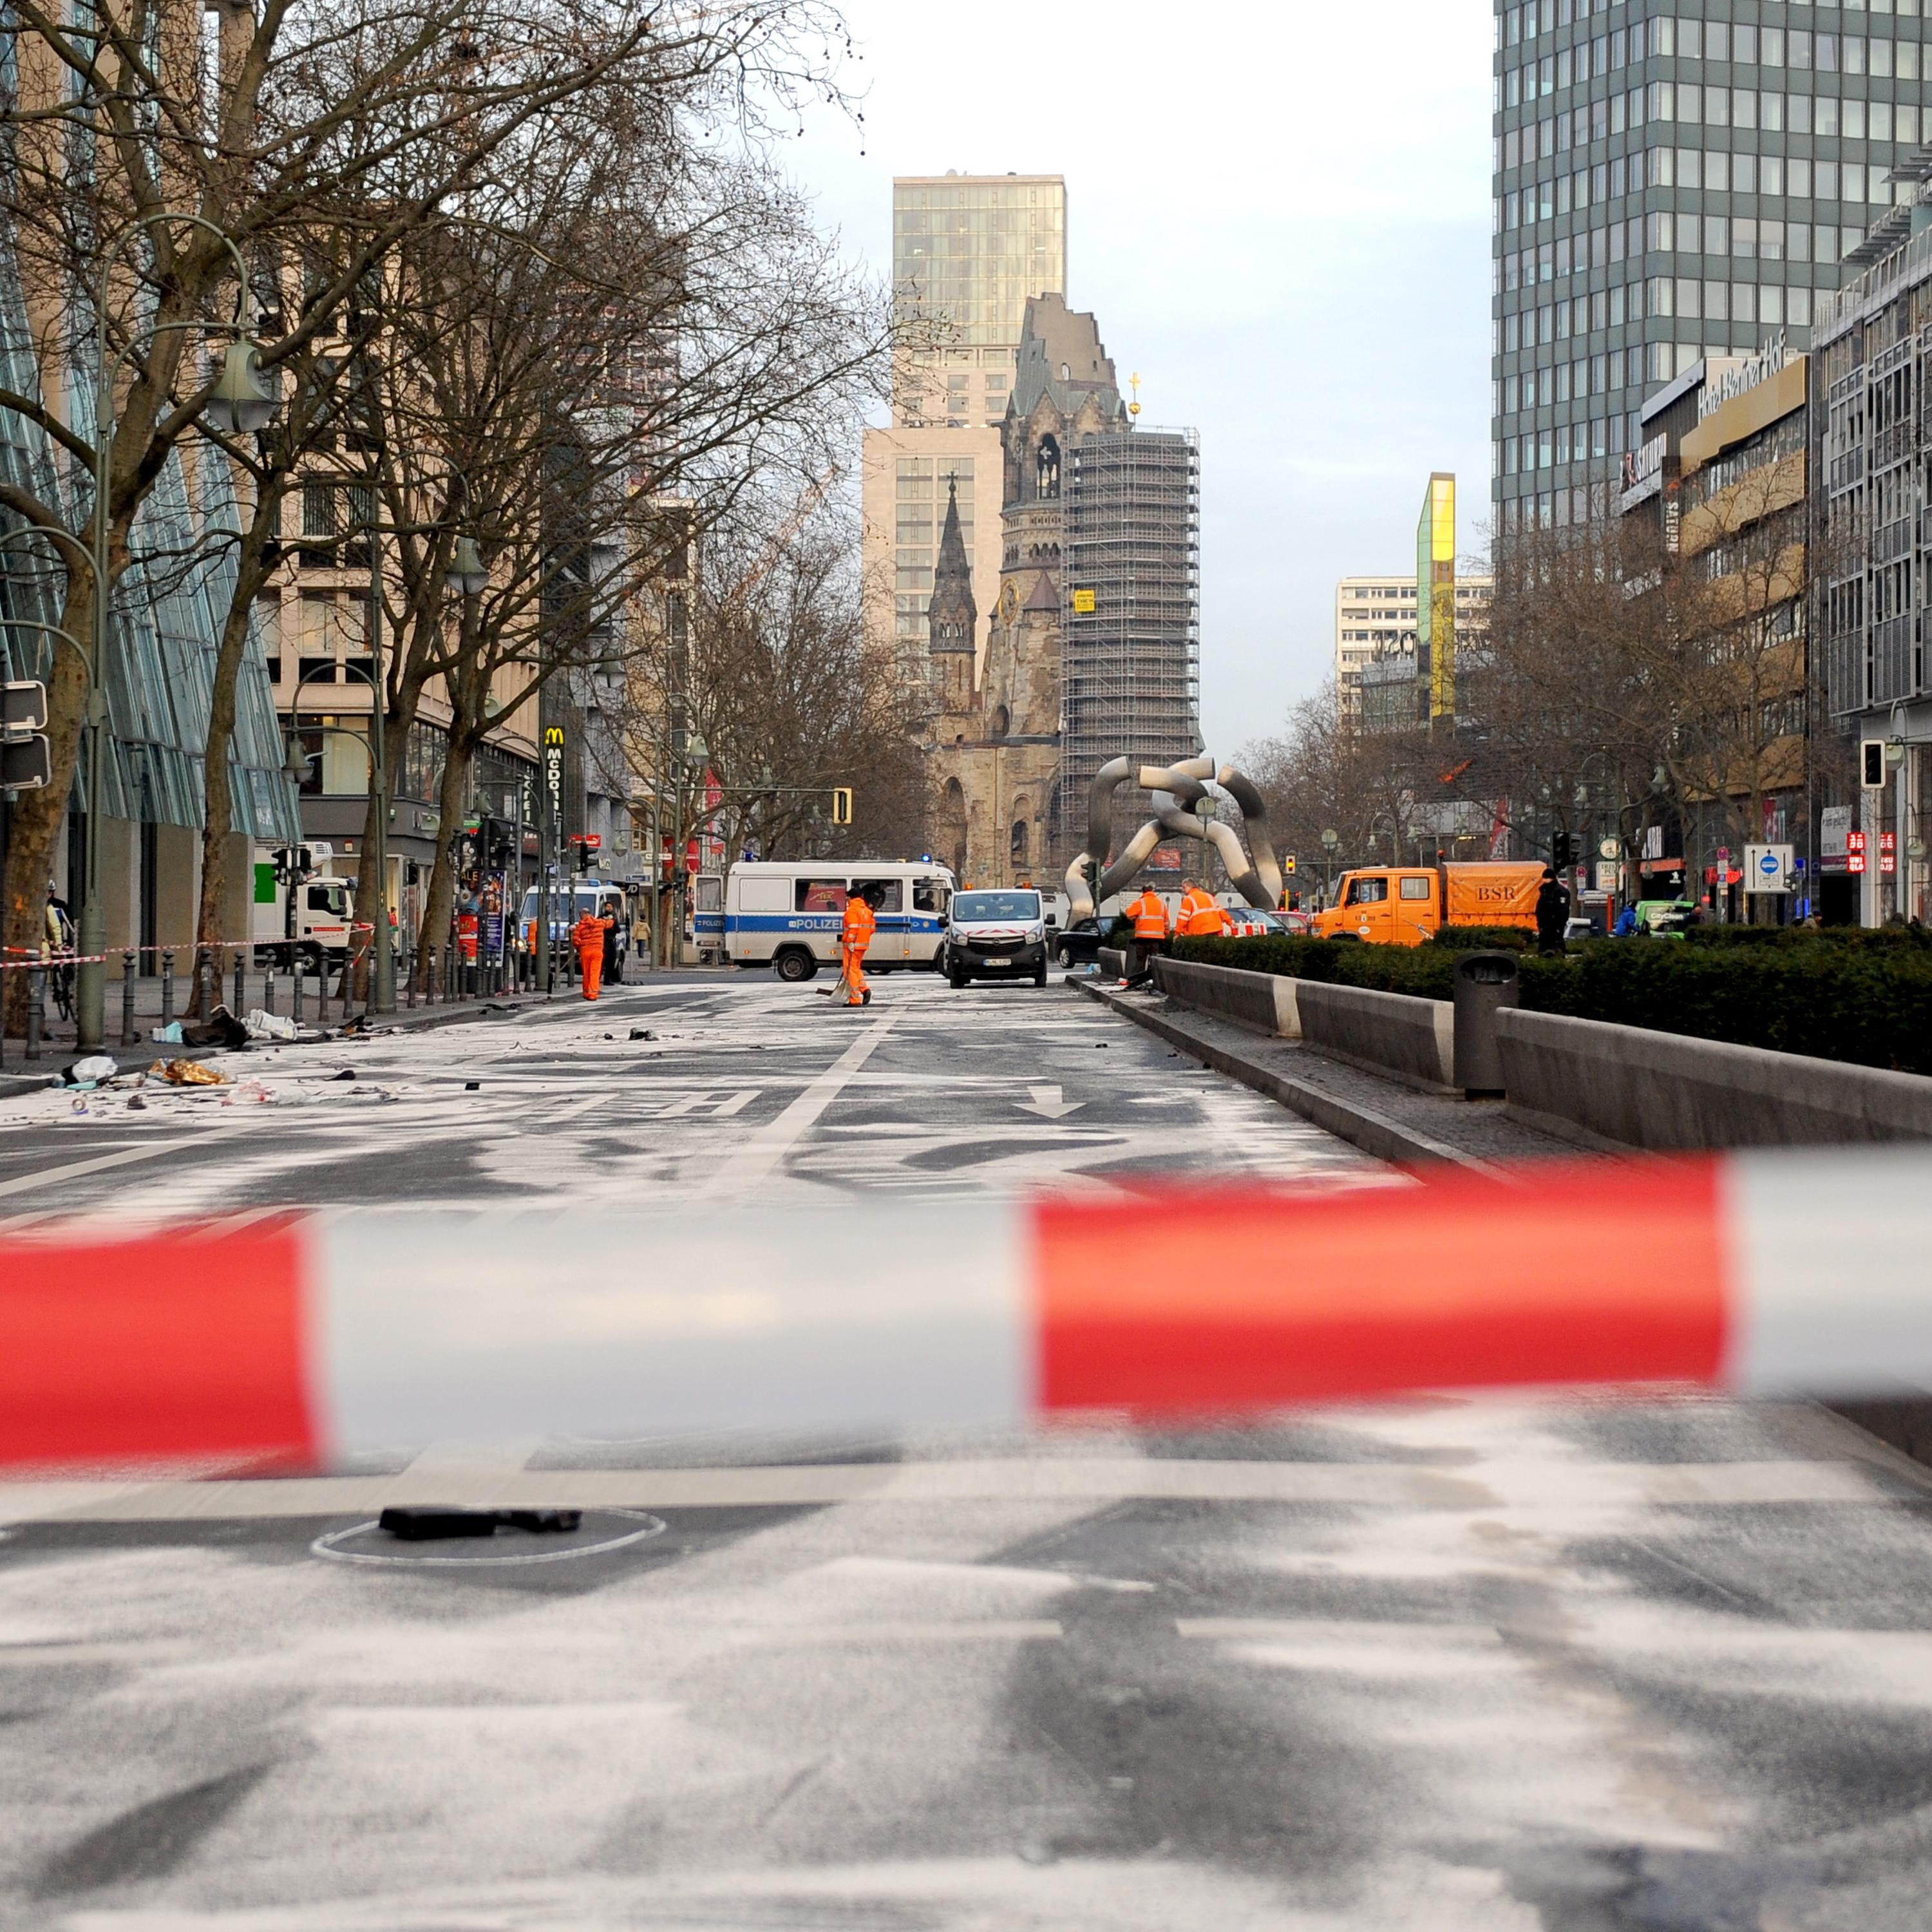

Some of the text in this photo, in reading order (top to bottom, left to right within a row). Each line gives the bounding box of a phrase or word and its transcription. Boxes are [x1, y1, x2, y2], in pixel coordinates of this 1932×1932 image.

[1698, 328, 1786, 426] Hotel Berliner Hof
[1636, 432, 1667, 481] SATURN
[1666, 502, 1679, 552] SATURN
[627, 884, 638, 894] JD
[1478, 887, 1515, 900] BSR
[797, 919, 843, 929] POLIZEI
